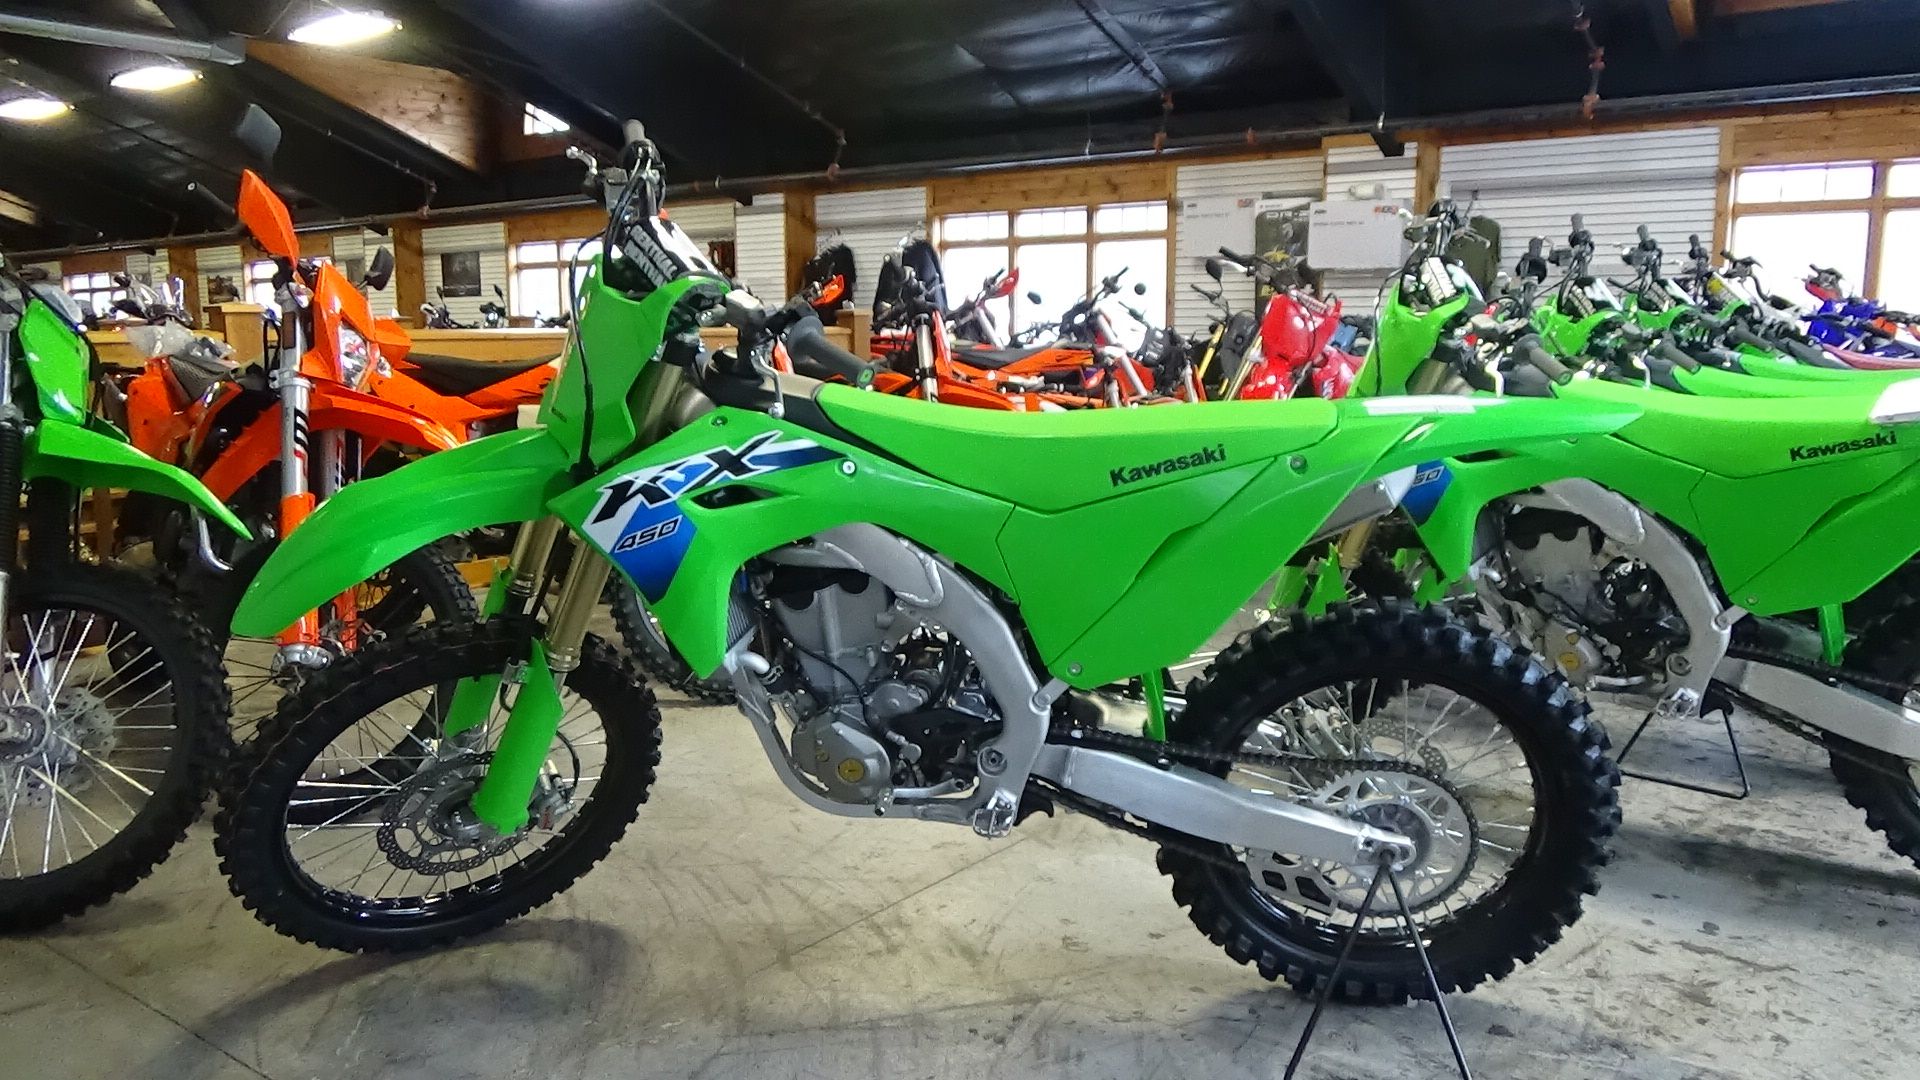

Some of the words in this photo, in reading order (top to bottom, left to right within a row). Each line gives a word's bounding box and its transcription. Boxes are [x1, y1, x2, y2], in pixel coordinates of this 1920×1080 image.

[1109, 443, 1227, 487] Kawasaki
[1789, 430, 1897, 462] Kawasaki
[590, 430, 784, 526] KX
[1412, 466, 1445, 488] 50
[614, 514, 683, 553] 450
